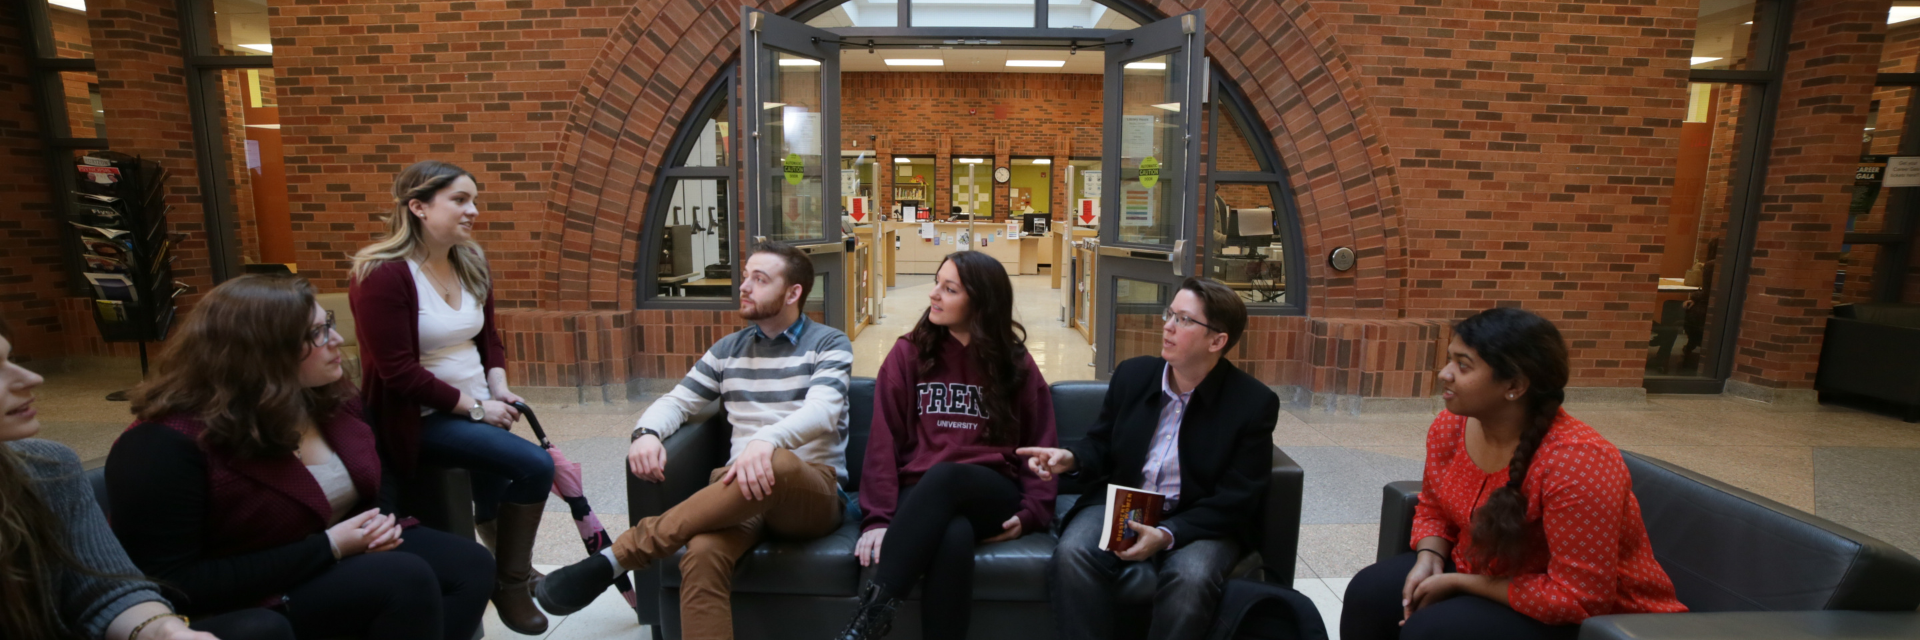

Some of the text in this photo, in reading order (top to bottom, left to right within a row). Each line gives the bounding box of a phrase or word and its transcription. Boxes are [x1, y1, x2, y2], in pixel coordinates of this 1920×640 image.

[916, 381, 989, 419] TREN
[937, 420, 978, 430] UNIVERSITY
[1124, 493, 1133, 519] WOMEN
[1116, 504, 1127, 542] DISSIDENT
